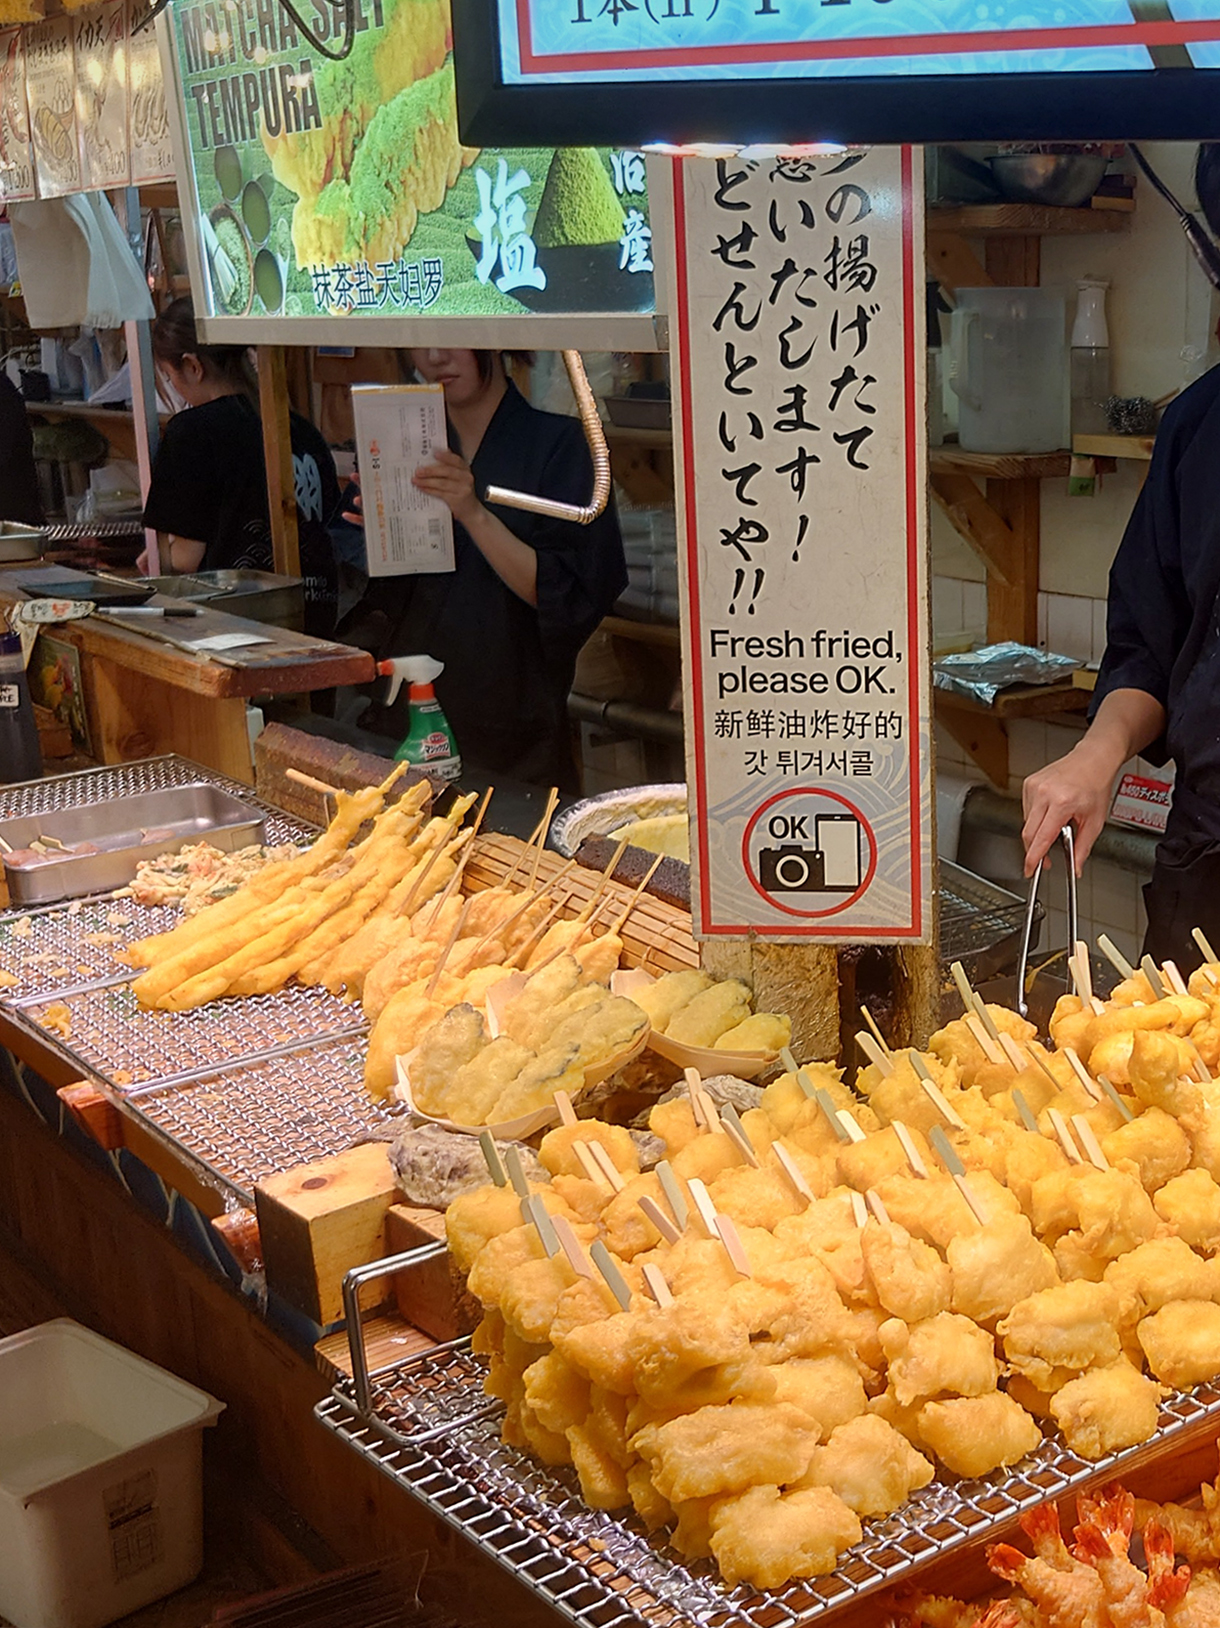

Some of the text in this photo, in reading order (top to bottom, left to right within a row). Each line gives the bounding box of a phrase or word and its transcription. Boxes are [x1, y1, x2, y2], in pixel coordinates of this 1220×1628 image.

[190, 59, 322, 149] TEMPURA
[311, 256, 445, 311] 抹茶盐天妇罗
[709, 629, 903, 663] Fresh fried,
[717, 665, 896, 700] please OK.
[713, 708, 904, 741] 新鲜油炸好的
[743, 749, 875, 777] 갓 튀겨서콜
[768, 815, 809, 841] OK
